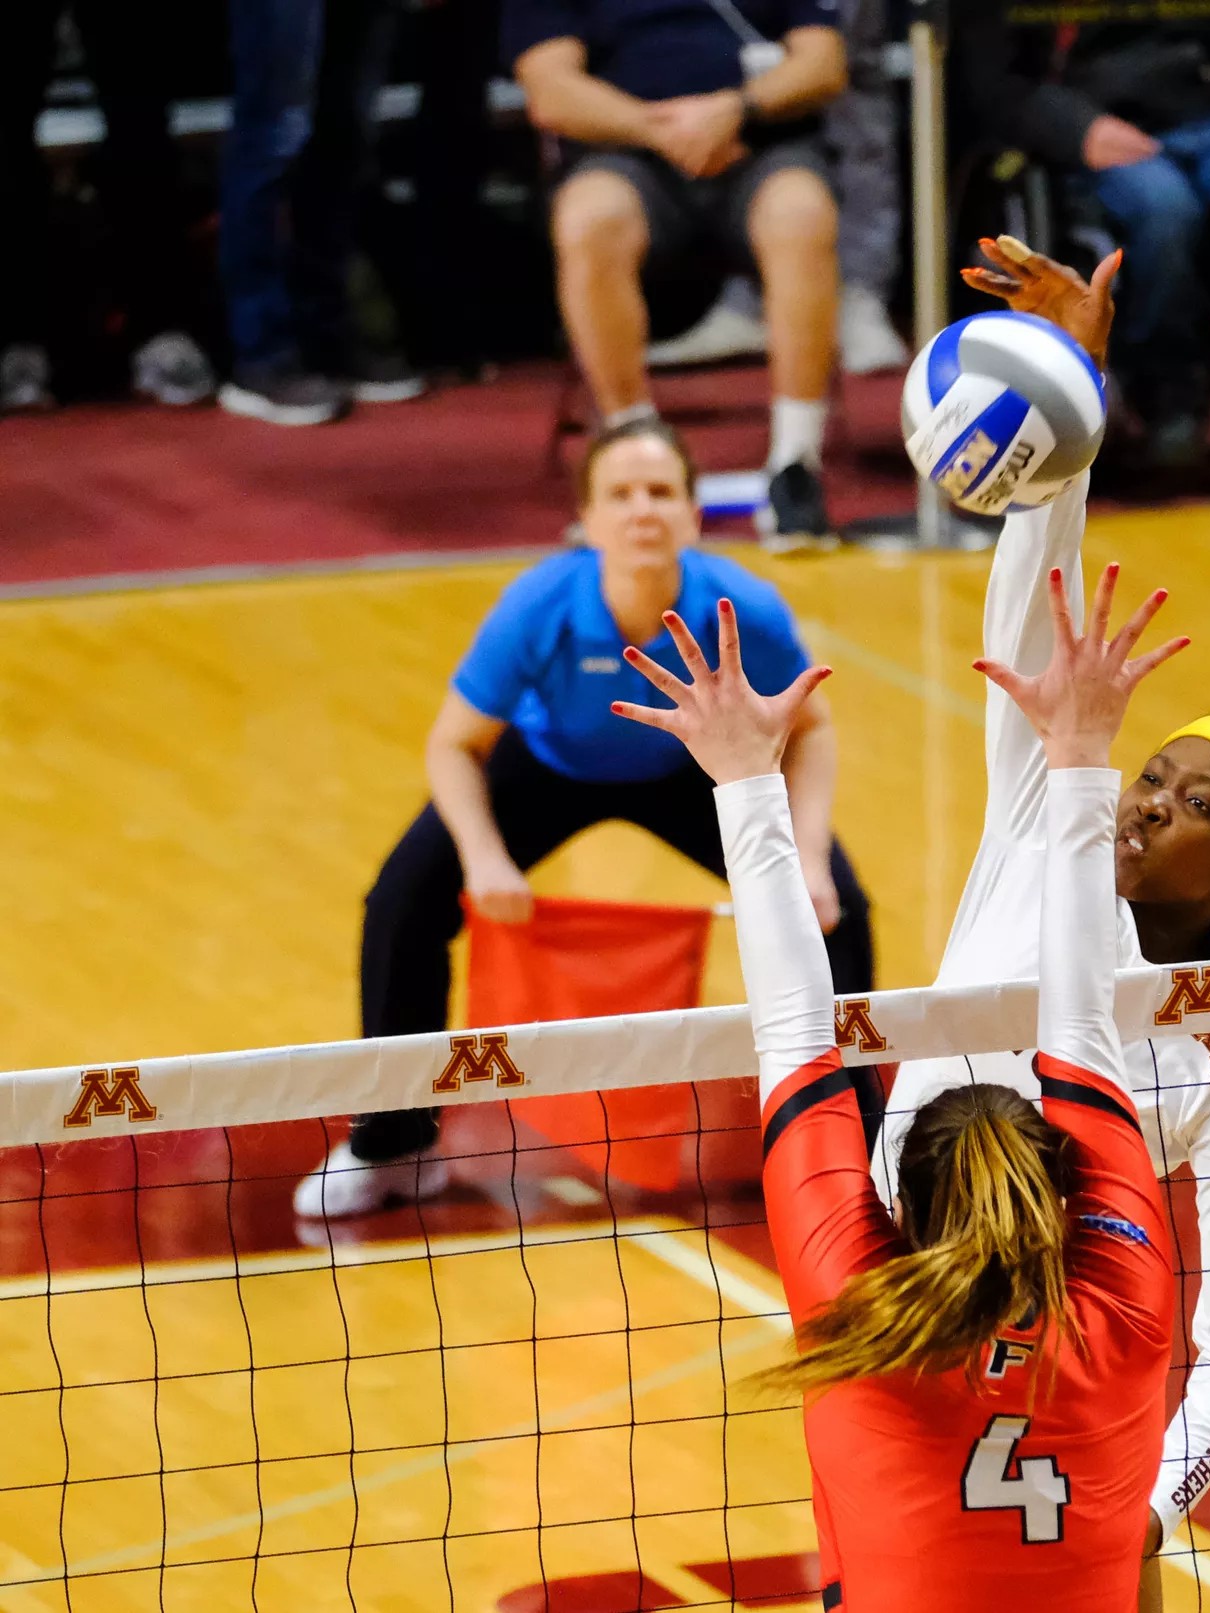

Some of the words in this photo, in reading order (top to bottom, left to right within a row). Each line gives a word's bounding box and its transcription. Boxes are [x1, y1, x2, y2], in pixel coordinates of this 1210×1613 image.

[433, 1032, 524, 1093] M
[64, 1066, 156, 1128] M
[960, 1413, 1071, 1544] 4
